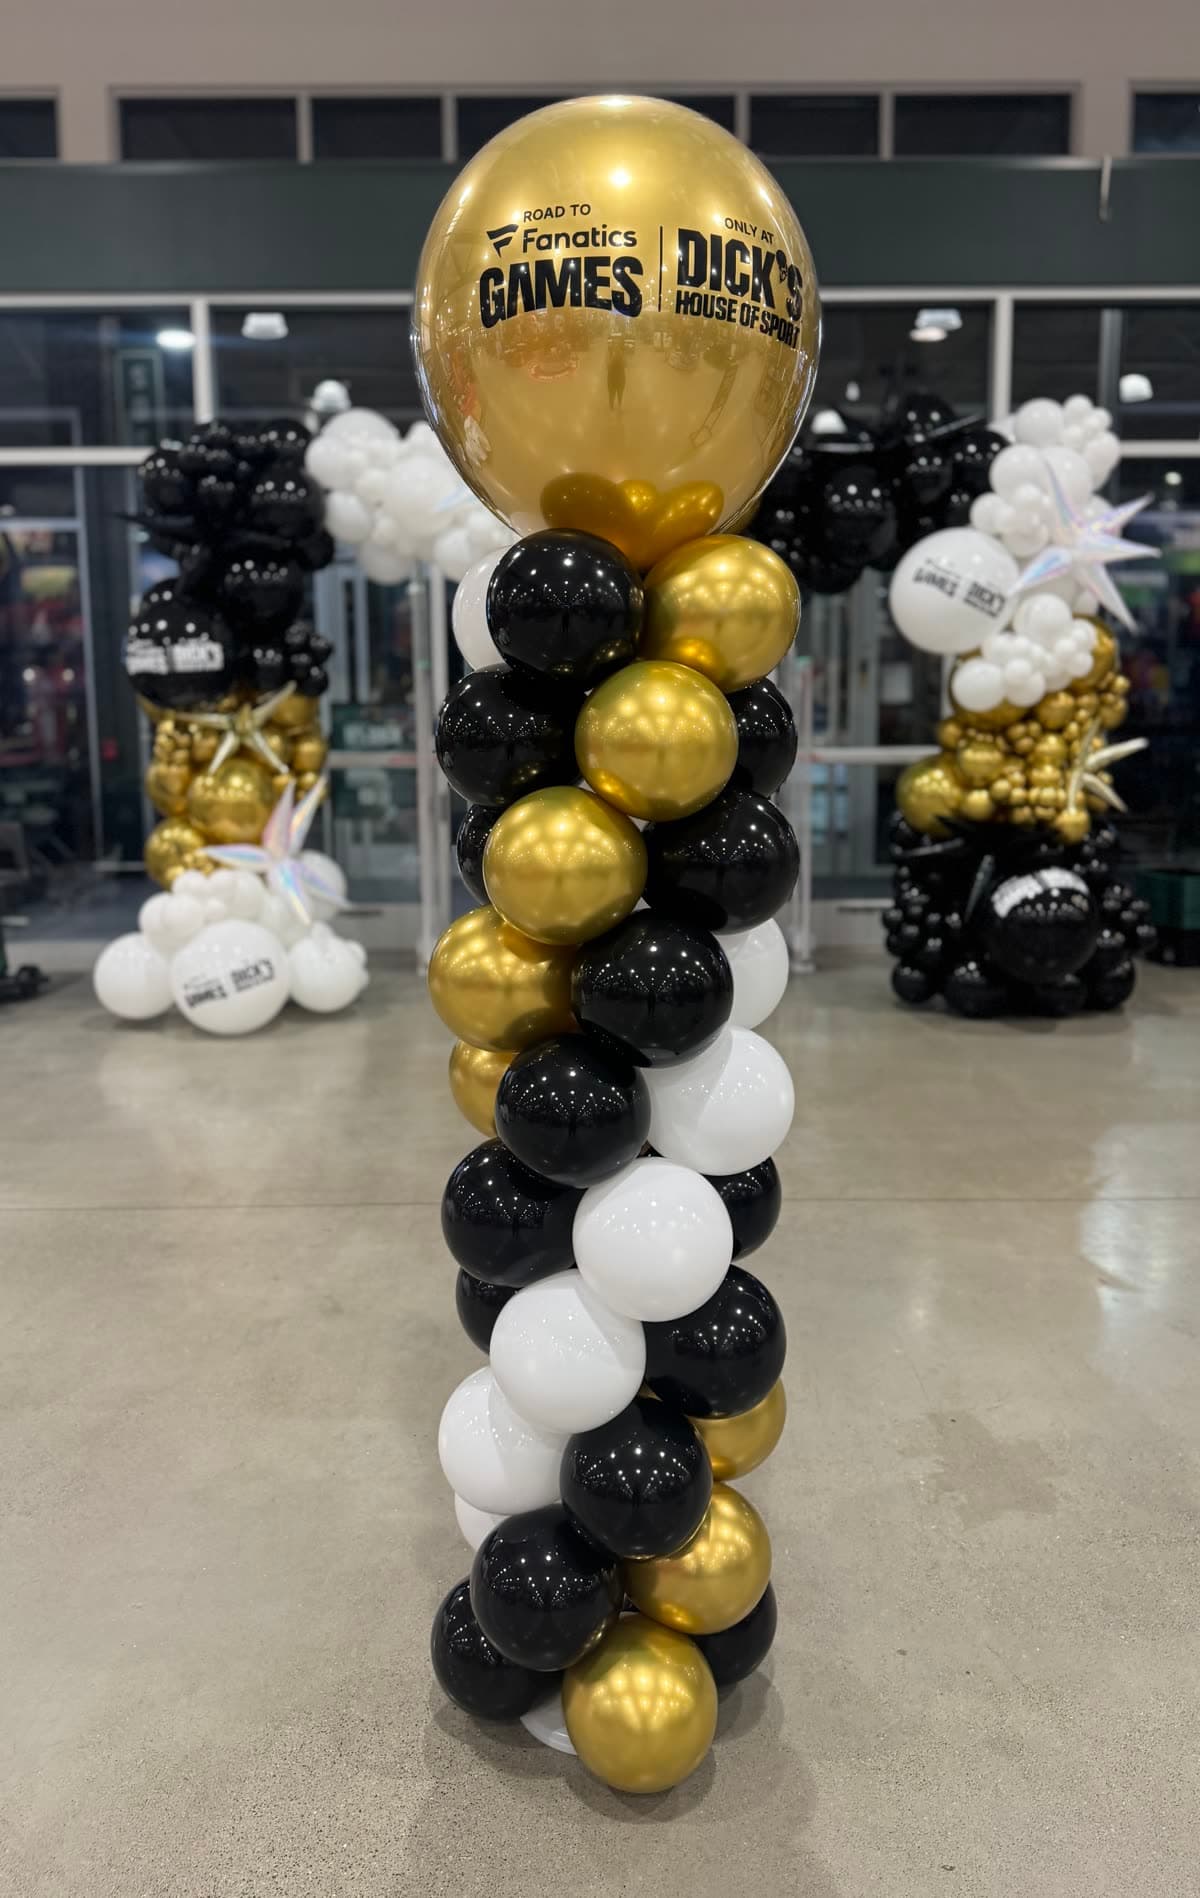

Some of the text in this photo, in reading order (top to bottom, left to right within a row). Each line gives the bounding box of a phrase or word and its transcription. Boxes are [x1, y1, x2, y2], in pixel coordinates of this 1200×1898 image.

[523, 203, 591, 223] ROAD TO
[724, 217, 775, 245] ONLY AT
[522, 224, 638, 254] Fanatics
[479, 255, 644, 329] GAMES
[677, 227, 803, 322] DICK'S
[675, 289, 801, 349] HOUSE OF SPORT
